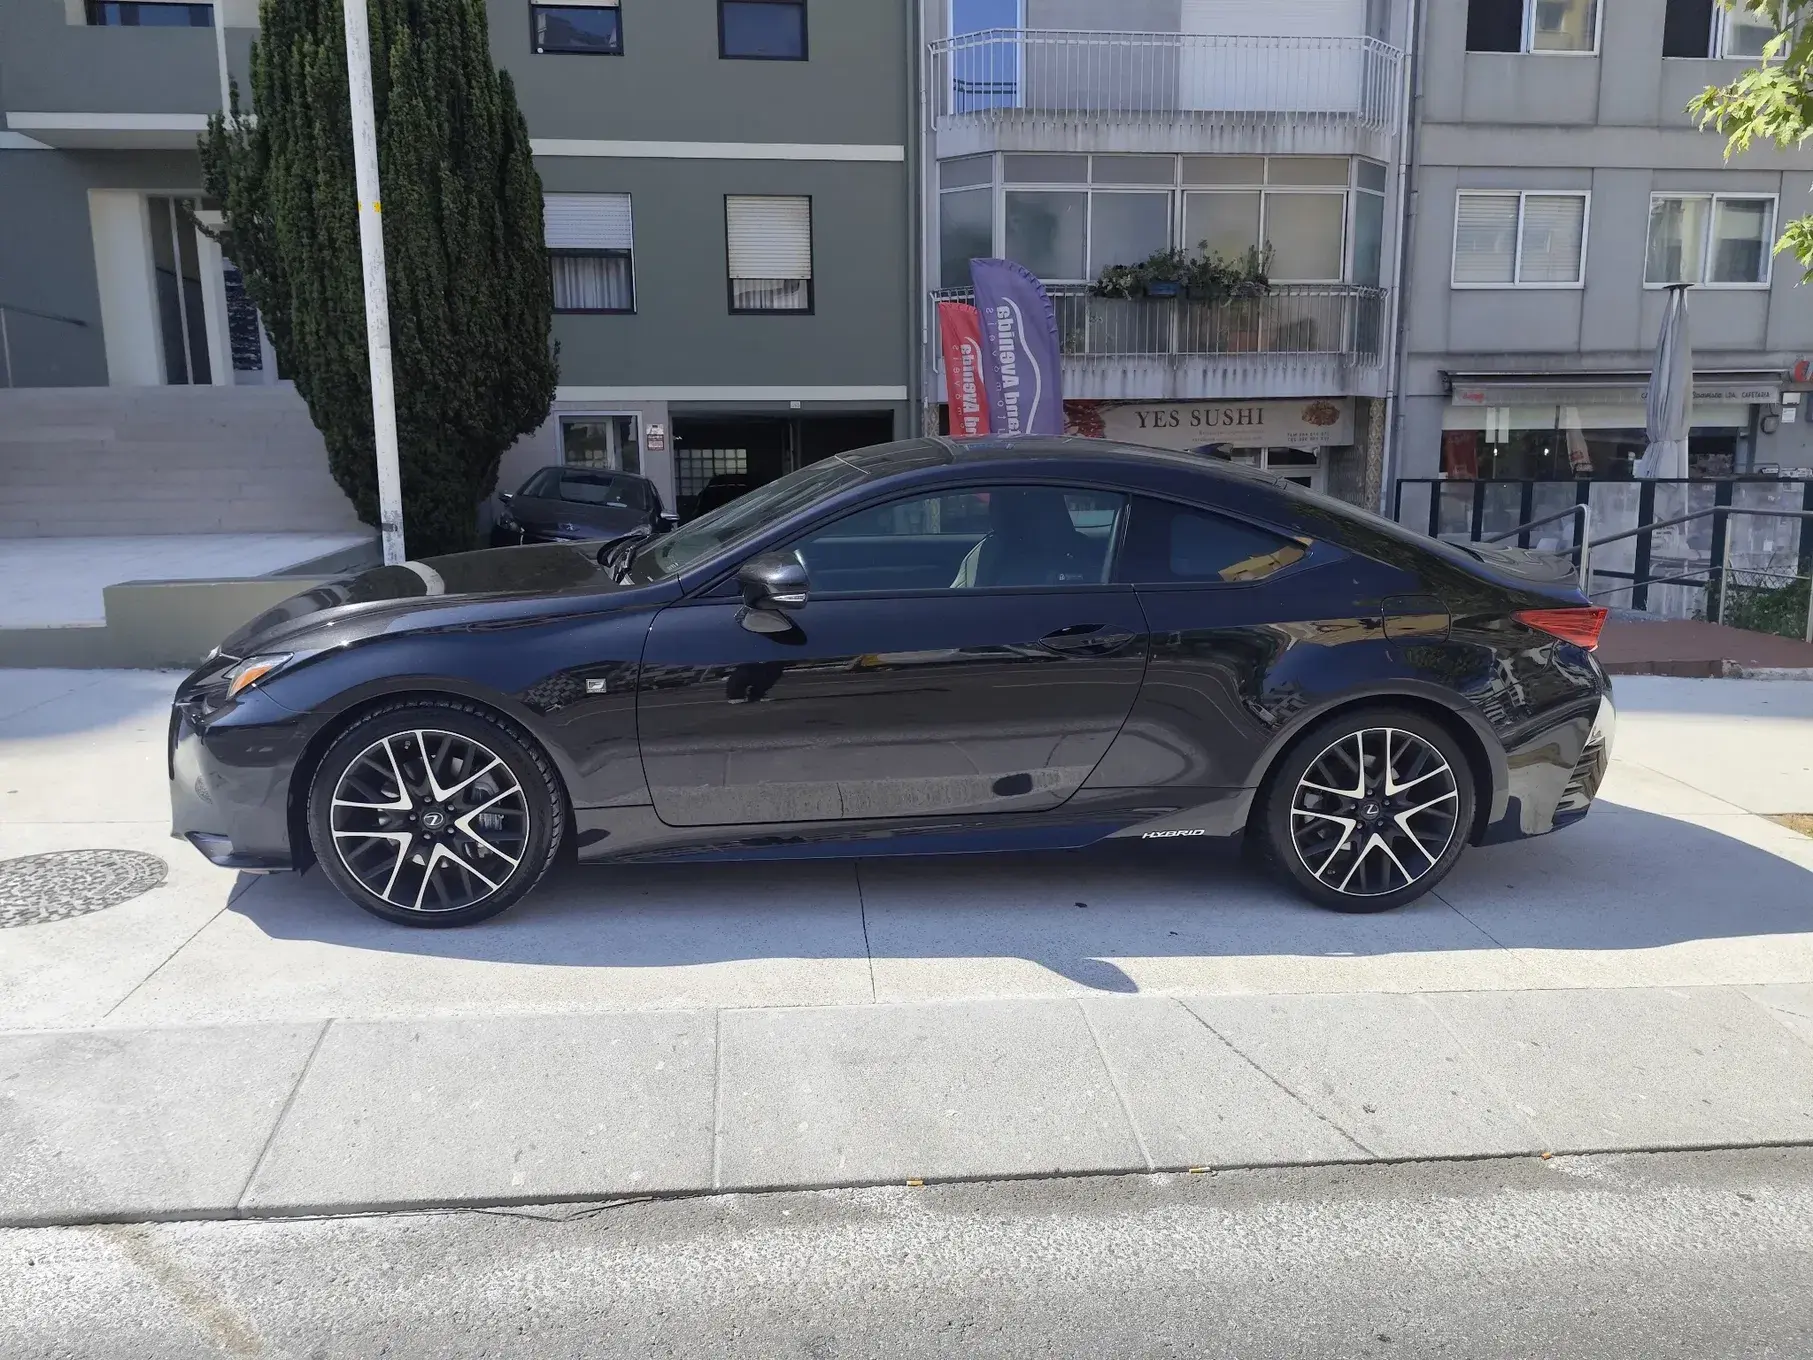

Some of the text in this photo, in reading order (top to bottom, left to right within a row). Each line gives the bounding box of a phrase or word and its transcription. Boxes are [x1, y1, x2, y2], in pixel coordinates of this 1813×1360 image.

[1135, 407, 1264, 428] YES SUSHI
[1142, 829, 1205, 839] HYBRID
